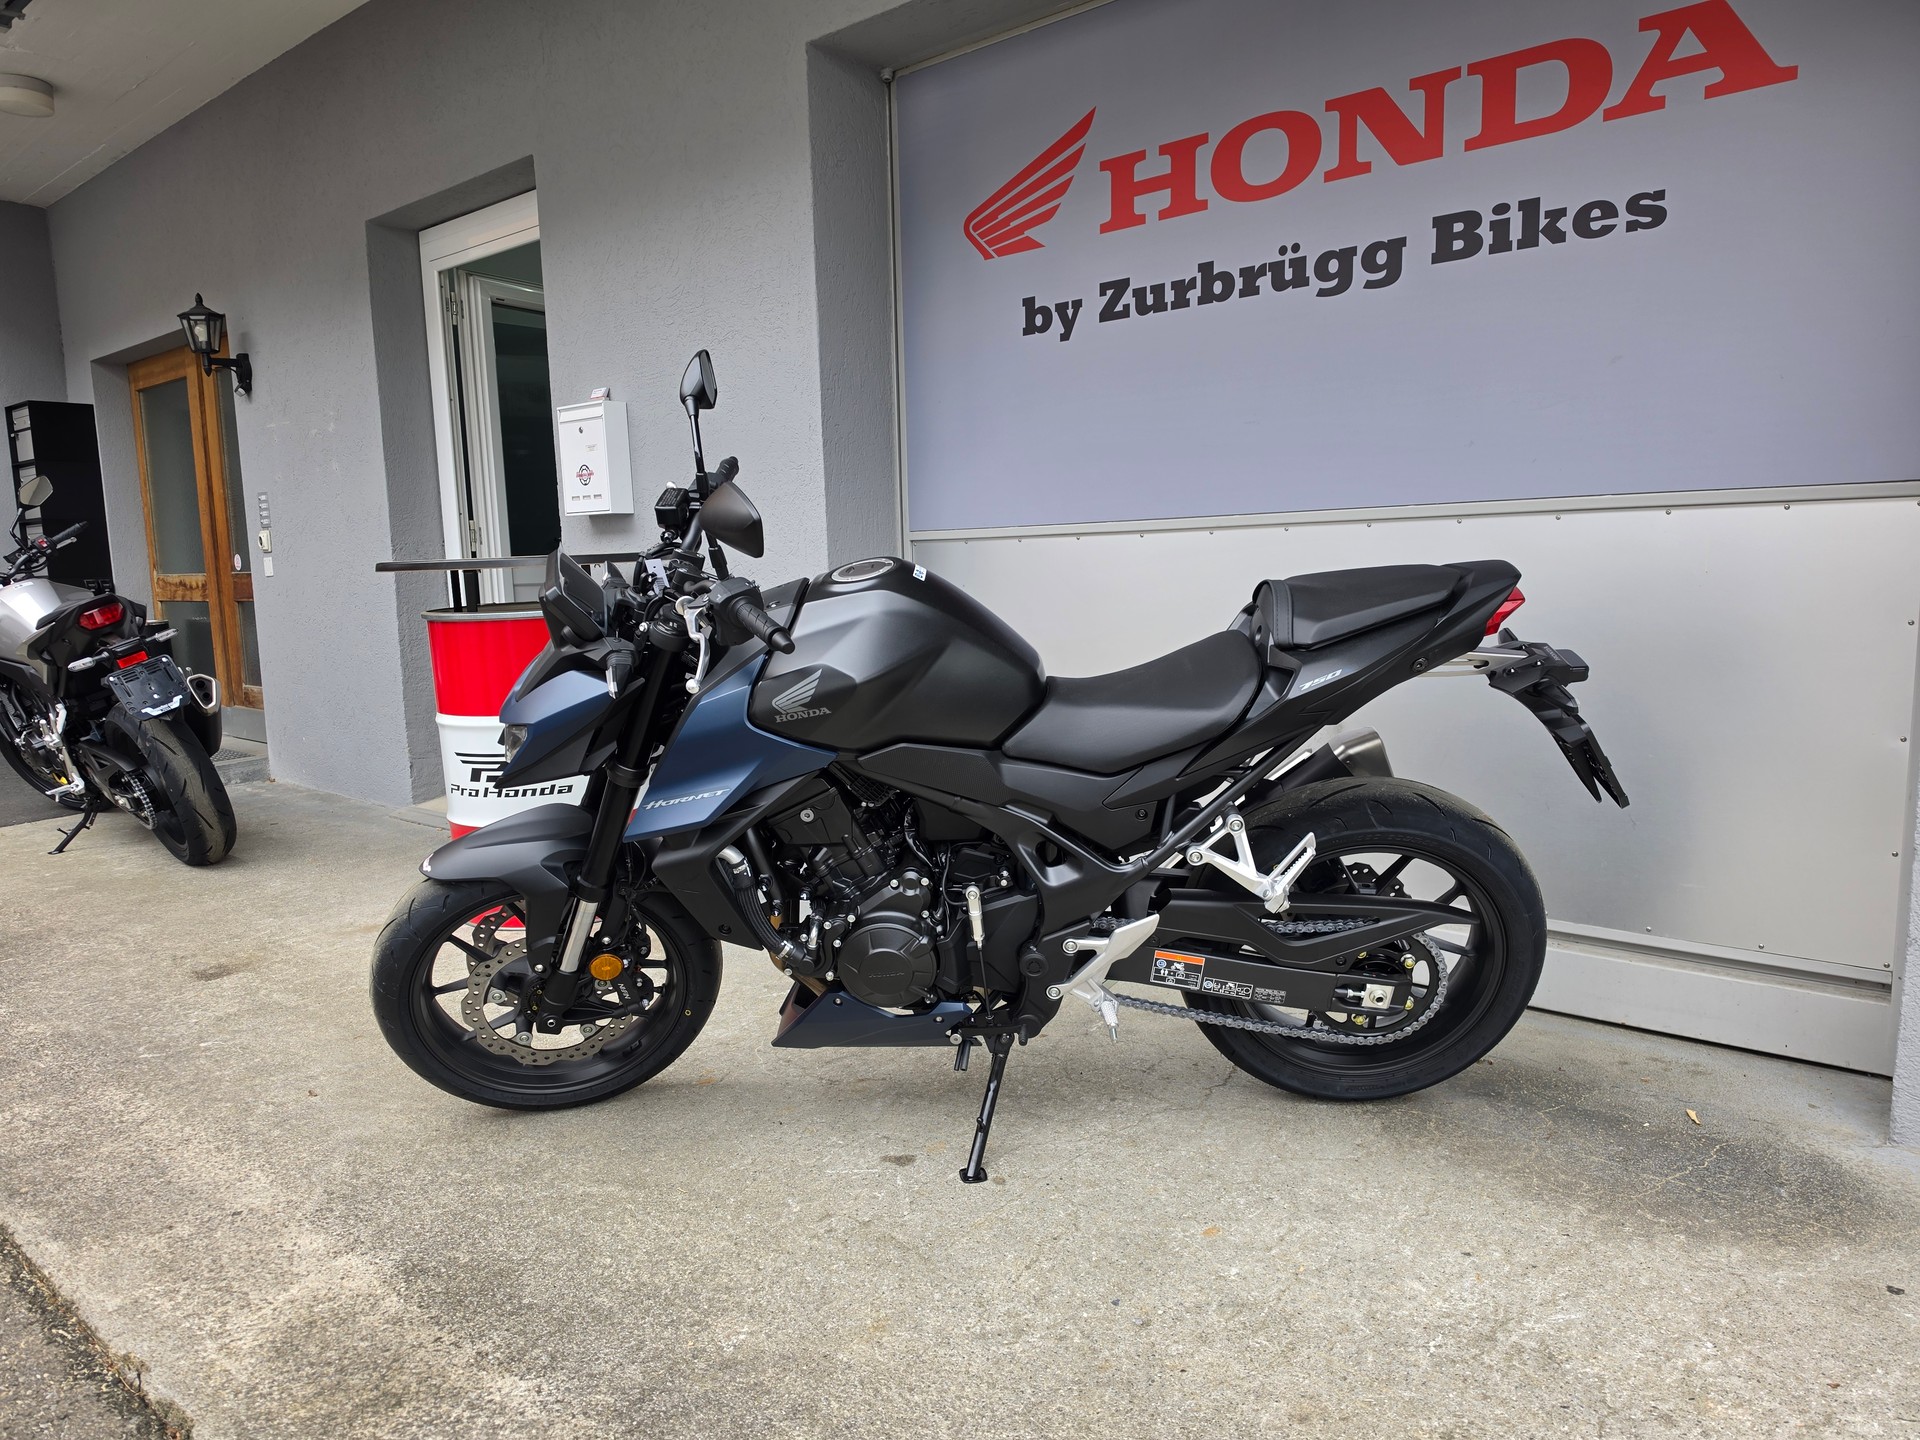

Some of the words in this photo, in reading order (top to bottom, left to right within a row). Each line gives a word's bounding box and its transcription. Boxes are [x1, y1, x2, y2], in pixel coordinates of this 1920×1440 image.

[1098, 0, 1799, 235] HONDA
[1022, 296, 1083, 342] by
[1097, 232, 1408, 324] Zurbrügg
[1430, 188, 1669, 266] Bikes
[774, 707, 832, 723] HONDA
[1299, 669, 1343, 691] 750
